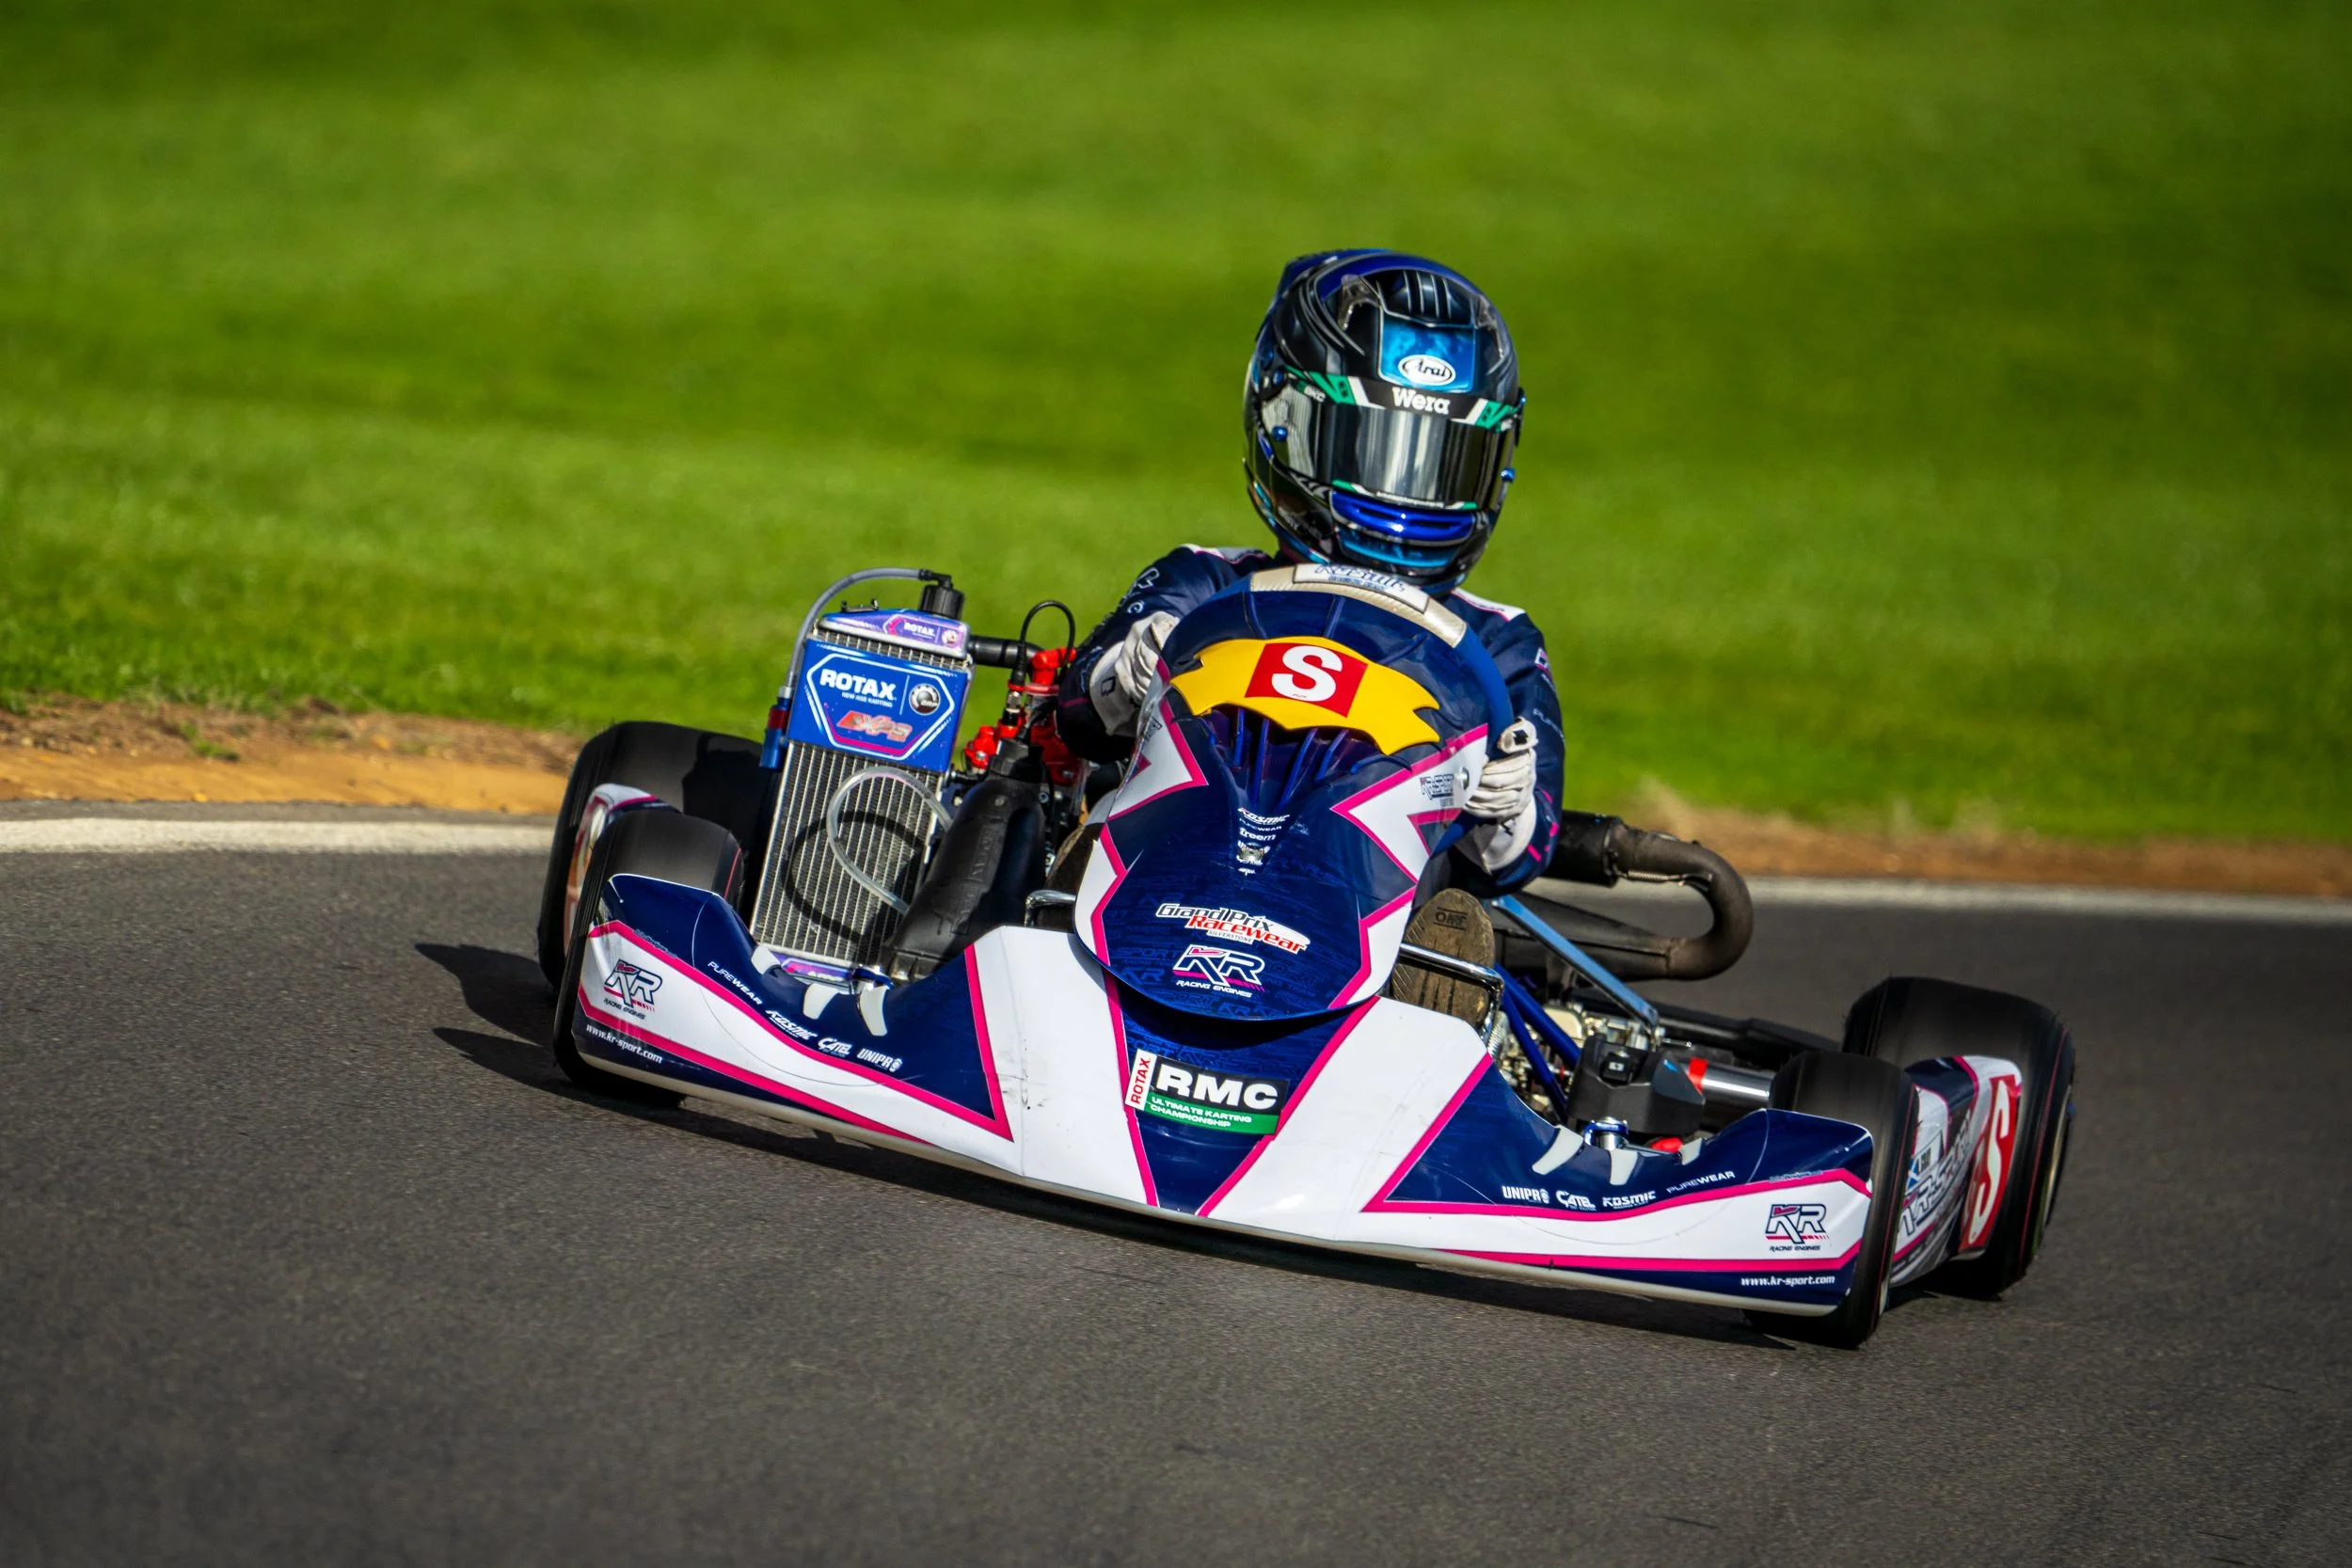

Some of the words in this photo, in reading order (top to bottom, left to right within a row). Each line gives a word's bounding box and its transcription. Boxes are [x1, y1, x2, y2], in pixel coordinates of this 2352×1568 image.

[1392, 387, 1451, 415] Wera
[903, 622, 935, 637] ROTAX
[819, 668, 896, 701] ROTAX
[1271, 645, 1343, 702] S
[841, 692, 855, 701] NEW
[867, 696, 893, 707] KARTING
[1188, 915, 1306, 952] Racewear
[1209, 930, 1252, 942] SILVERSTONE
[1172, 944, 1265, 987] KR
[604, 958, 662, 1008] KR
[707, 961, 763, 1005] PUREWEAR
[1176, 980, 1211, 990] RACING
[1213, 985, 1253, 998] ENGINES
[603, 997, 623, 1010] RACING
[623, 1006, 646, 1020] ENGINES
[586, 1023, 663, 1064] www.kr-sport.com
[1131, 1057, 1151, 1104] ROTAX
[1156, 1064, 1278, 1109] RMC
[1150, 1104, 1232, 1127] CHAMPIONSHIP
[1152, 1096, 1204, 1116] ULTIMATE
[1205, 1109, 1252, 1123] KARTING
[1968, 1080, 2010, 1244] S
[1666, 1171, 1736, 1194] PUREWEAR
[1765, 1203, 1827, 1244] KR
[1770, 1244, 1792, 1253] RACING
[1740, 1275, 1836, 1288] www.kr-sport.com
